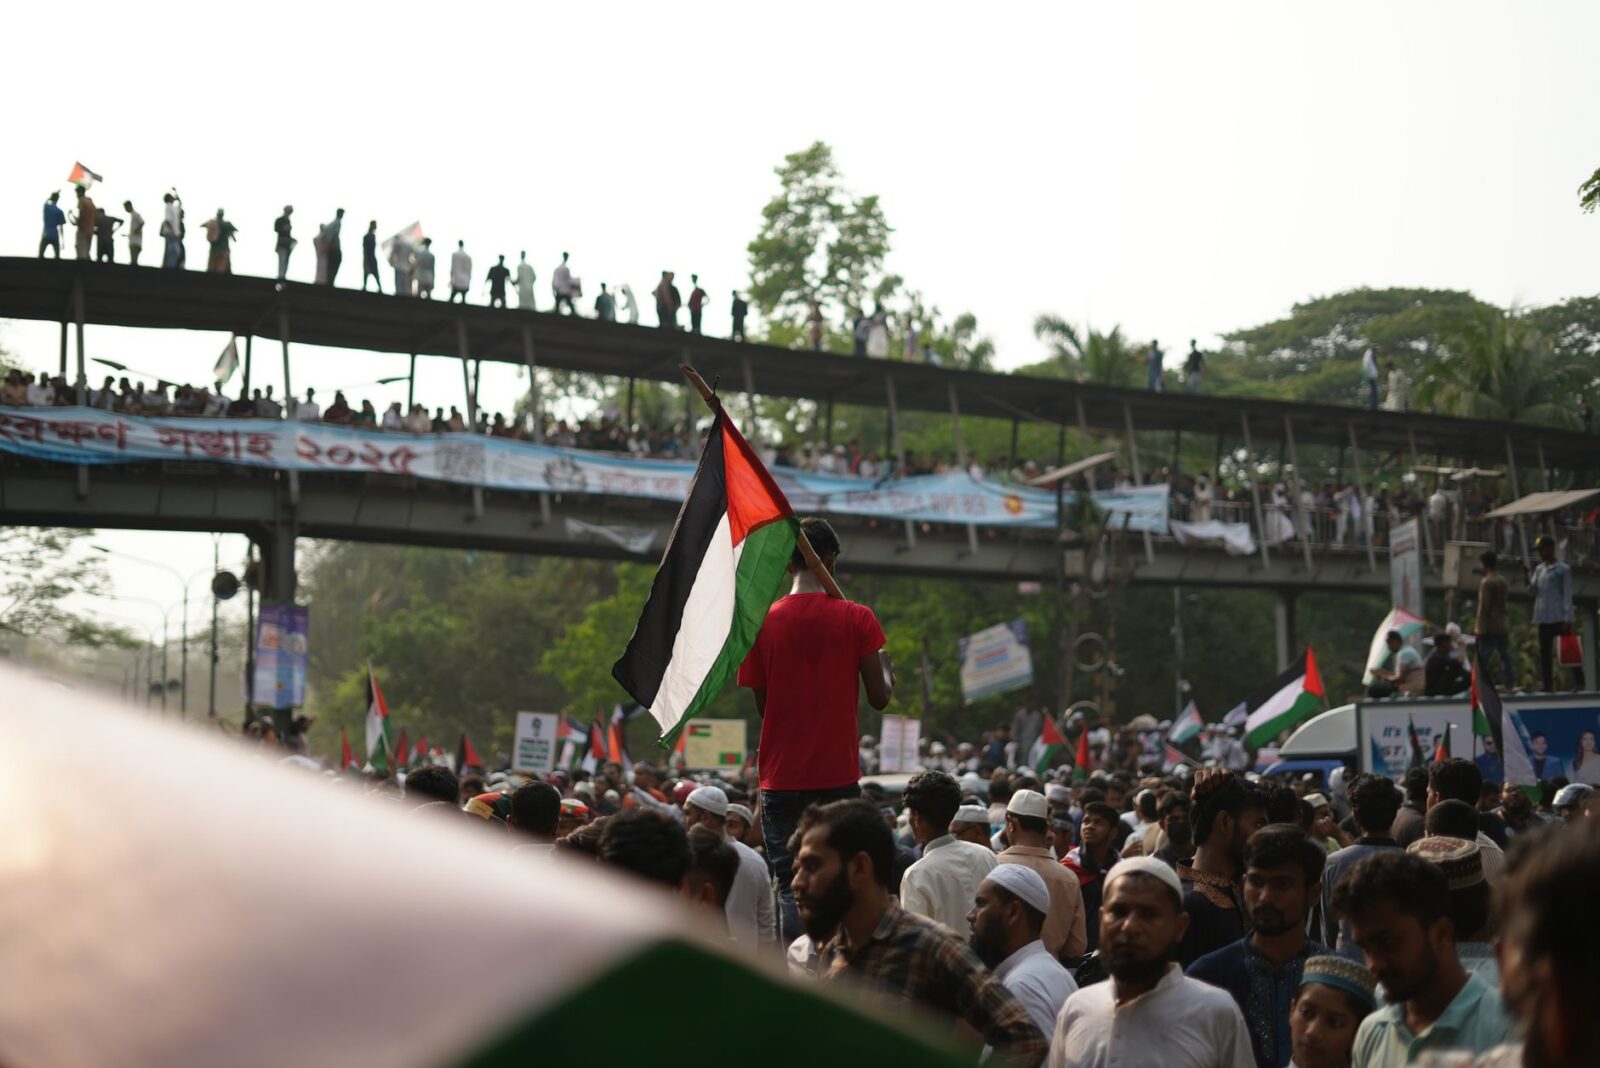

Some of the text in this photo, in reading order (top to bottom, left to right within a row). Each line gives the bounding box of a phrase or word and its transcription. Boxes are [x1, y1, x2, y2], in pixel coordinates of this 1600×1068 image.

[0, 413, 416, 473] ংরক্ষণ সপ্তাহ ২০২৫
